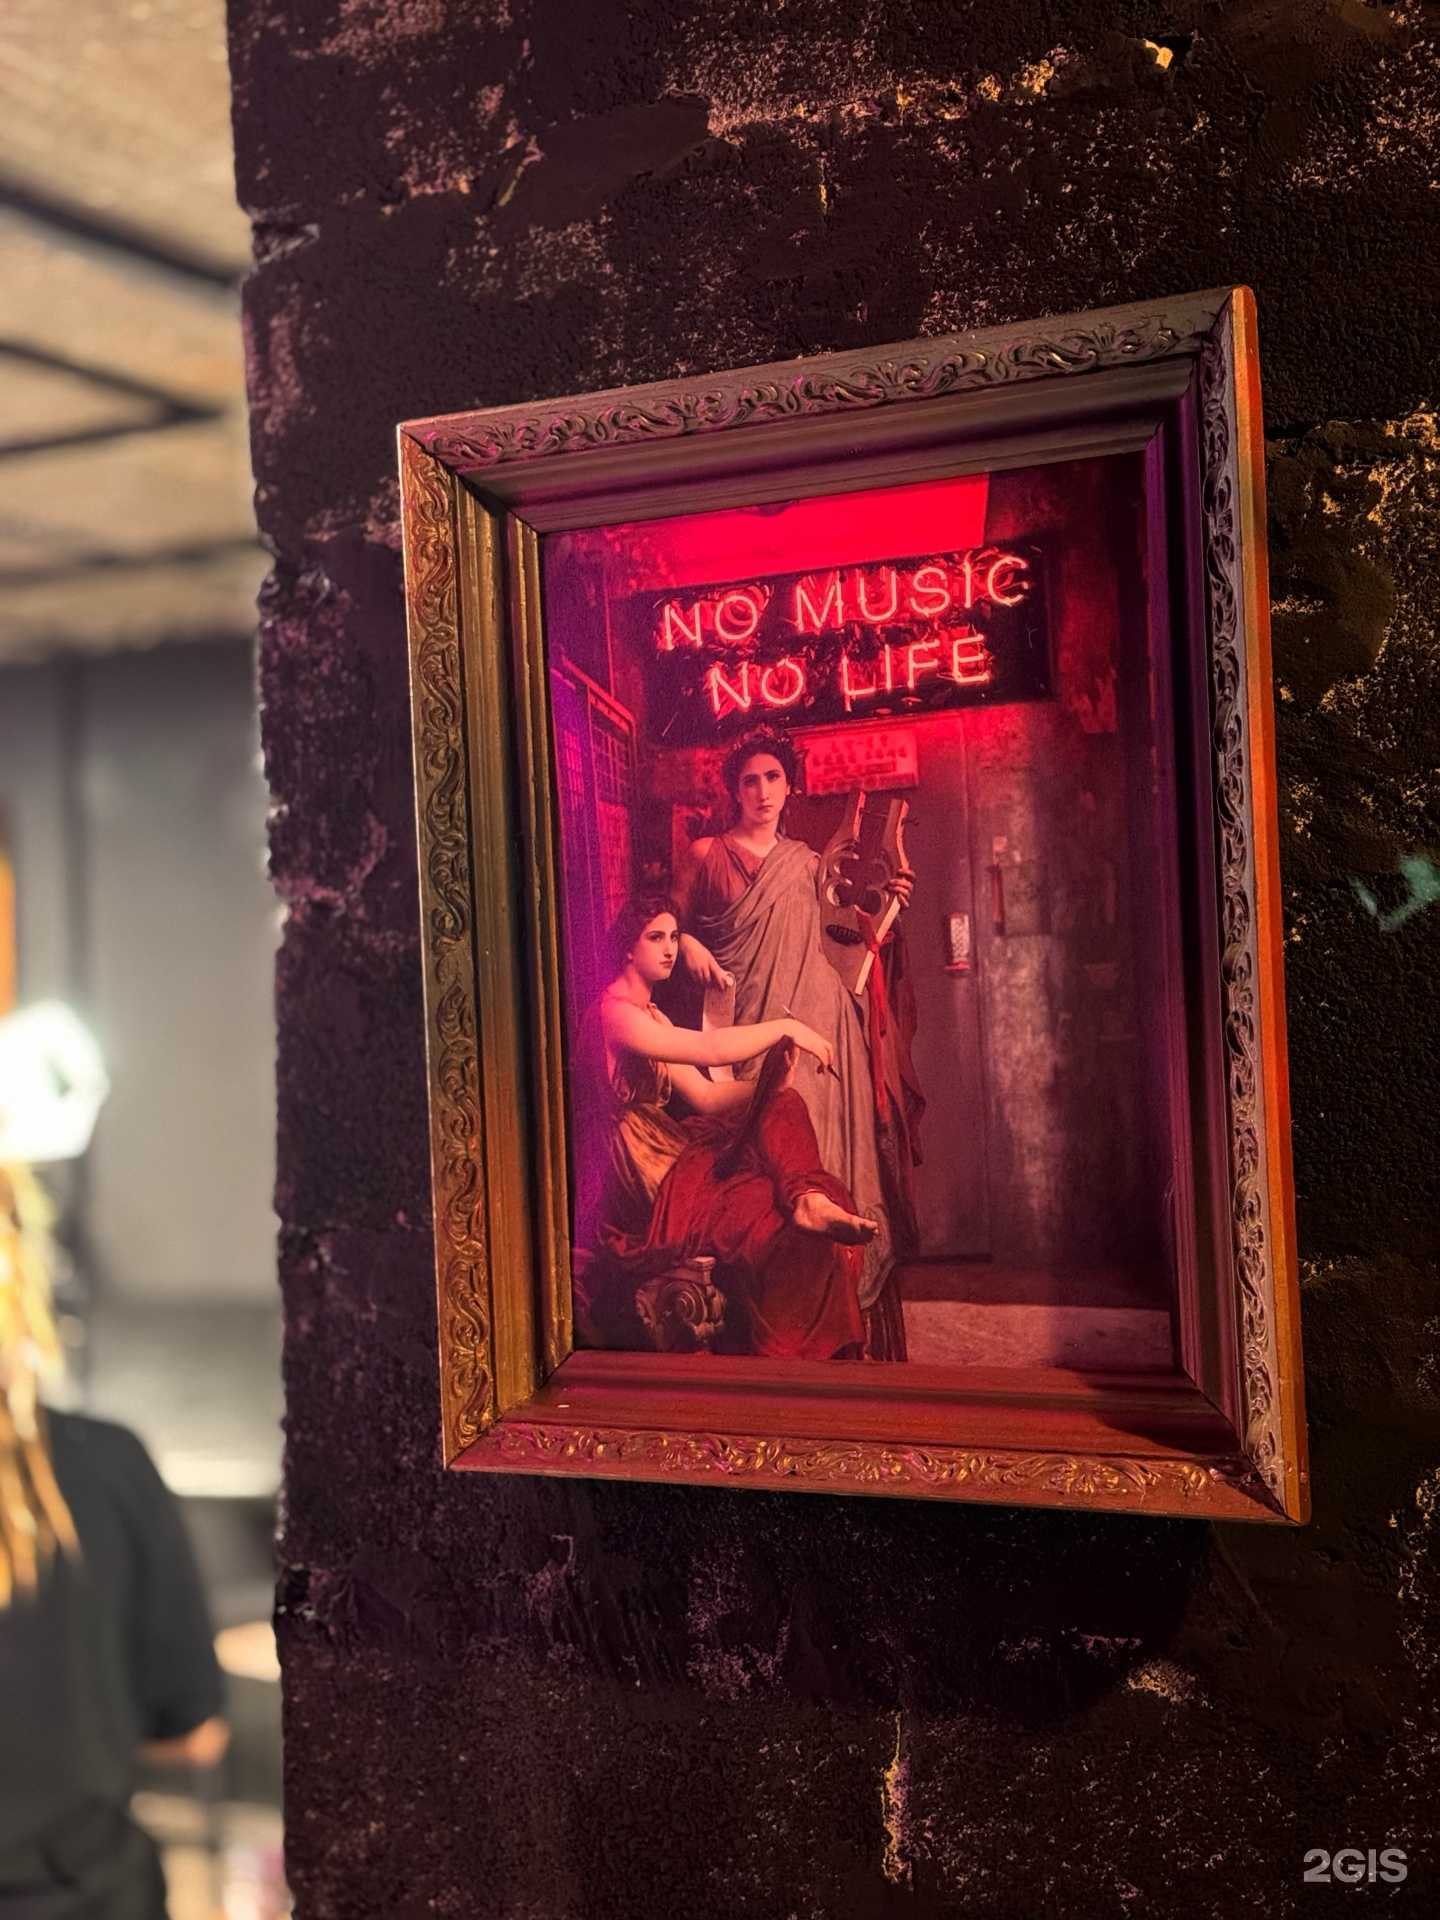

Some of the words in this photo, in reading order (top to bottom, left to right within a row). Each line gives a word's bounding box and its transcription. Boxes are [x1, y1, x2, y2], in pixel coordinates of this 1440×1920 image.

[664, 594, 758, 651] NO
[795, 555, 1029, 633] MUSIC
[710, 657, 804, 713] NO
[842, 634, 991, 698] LIFE
